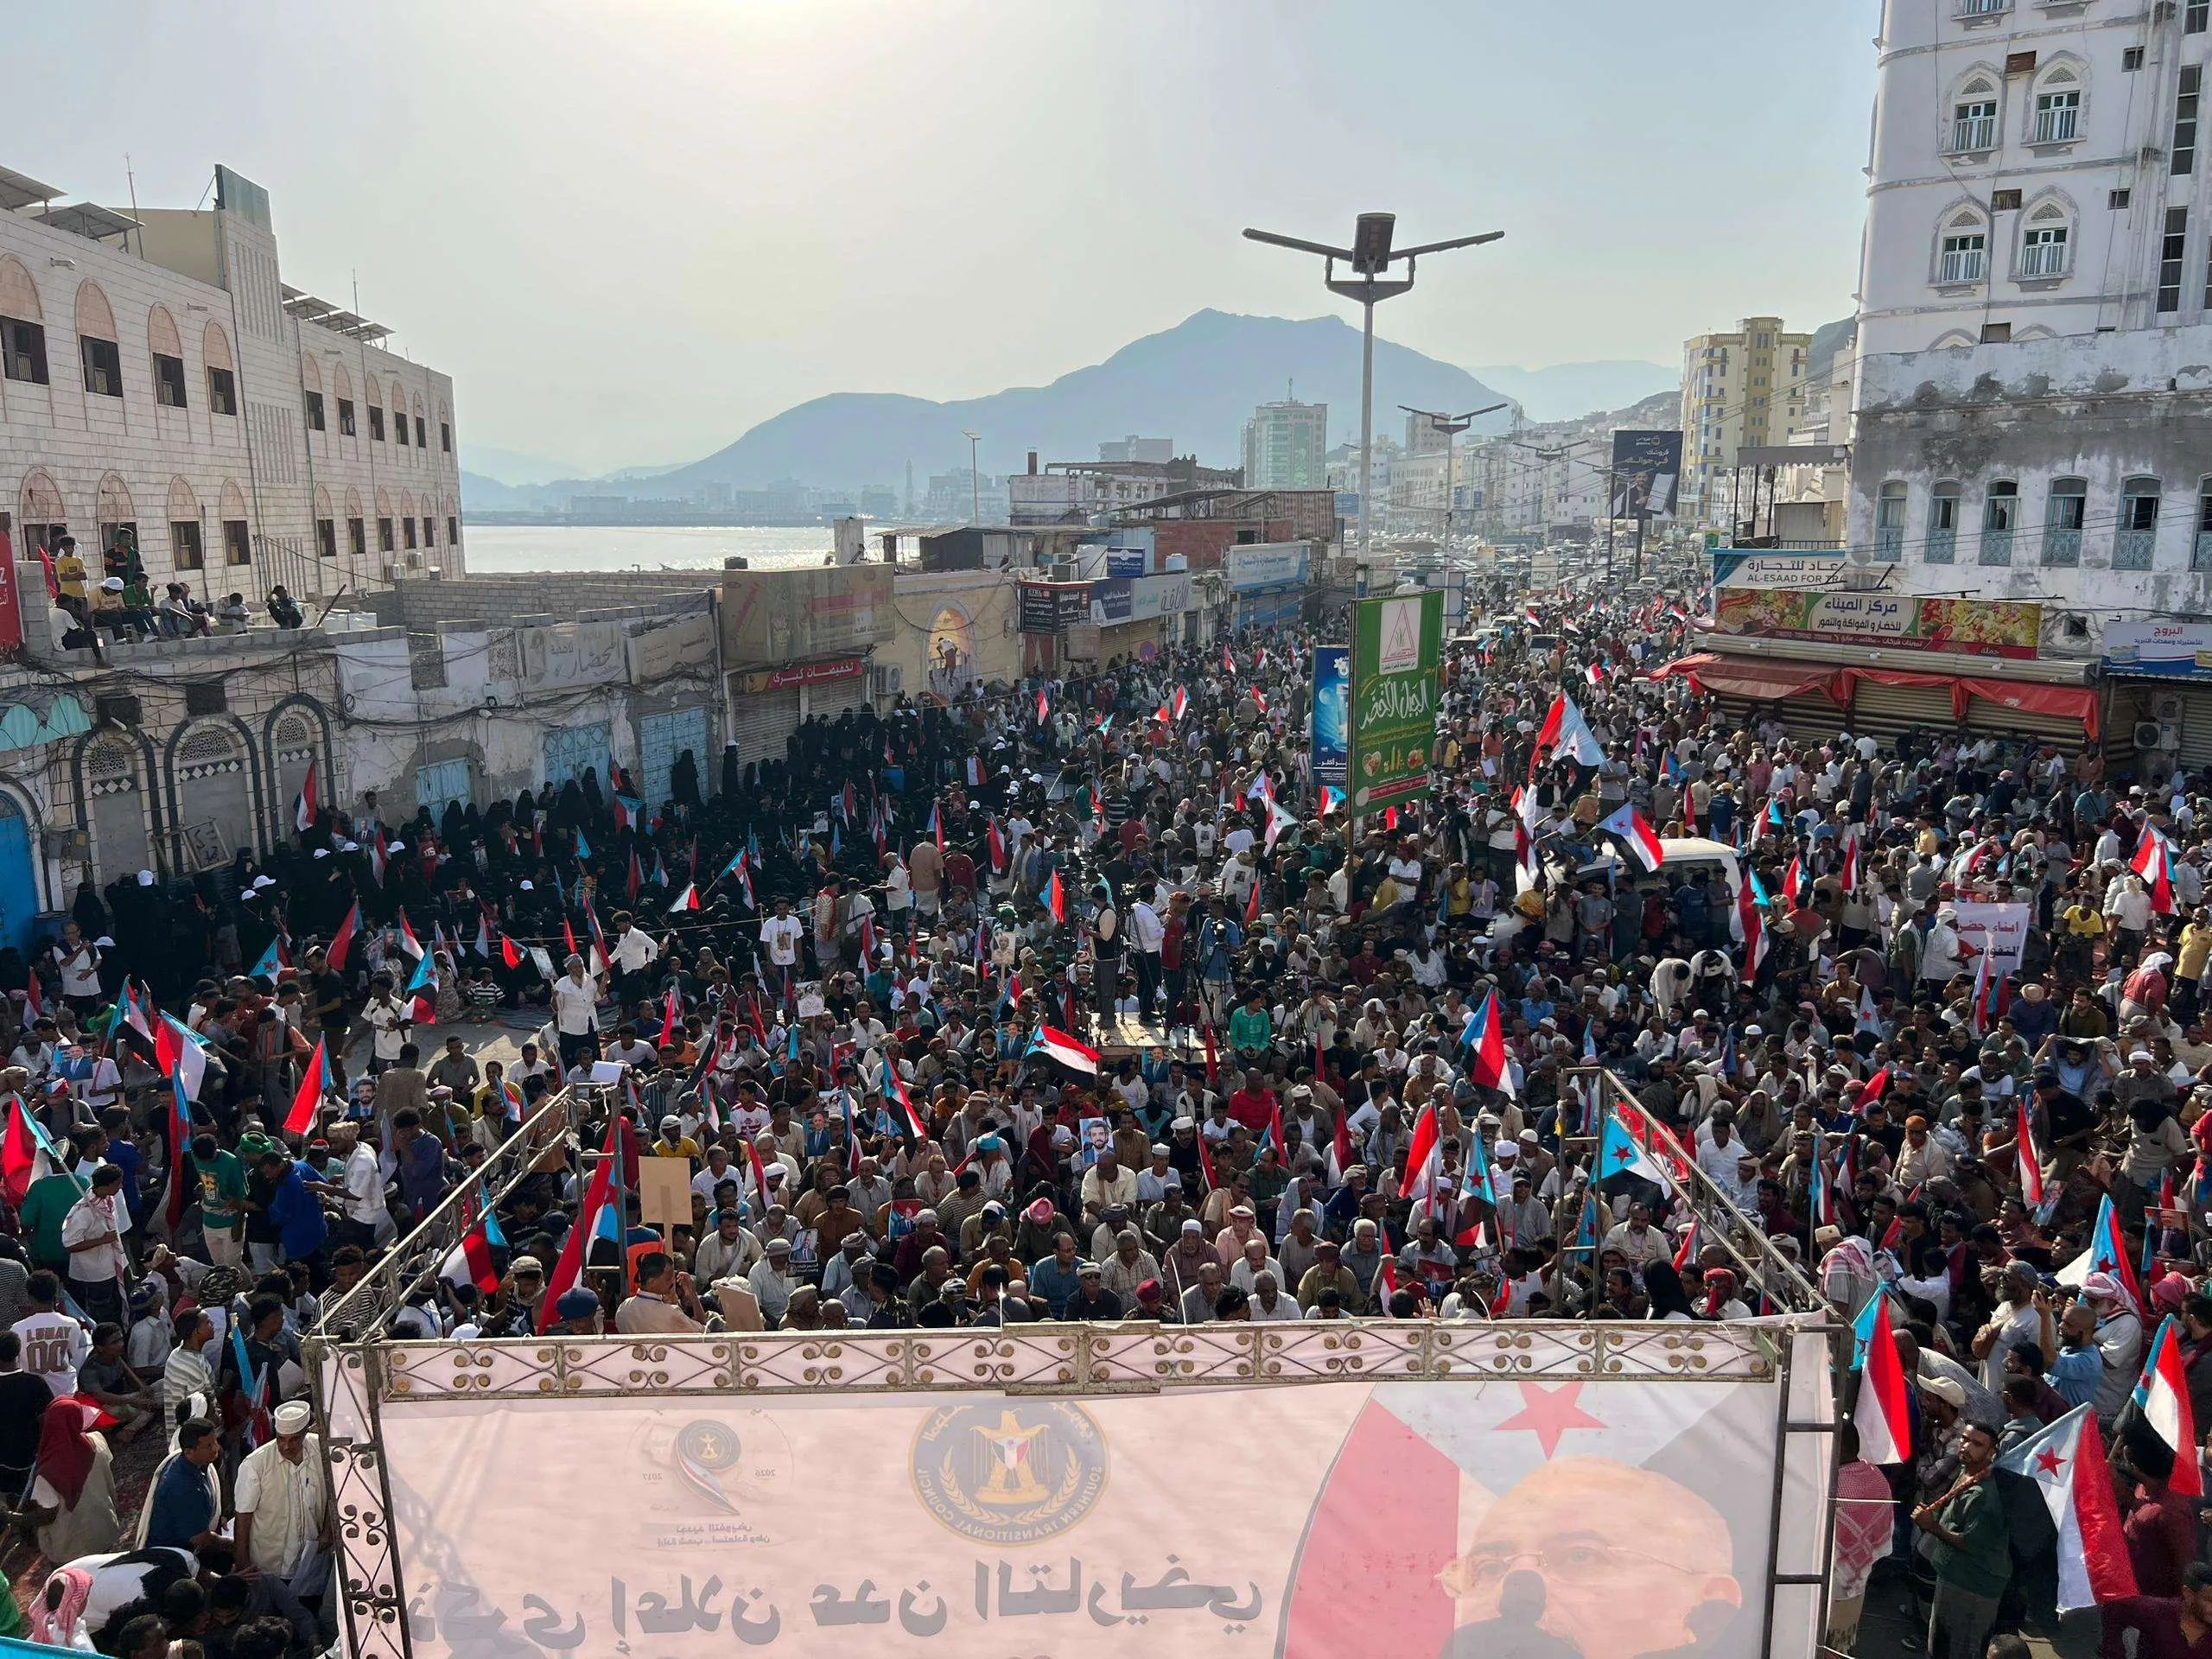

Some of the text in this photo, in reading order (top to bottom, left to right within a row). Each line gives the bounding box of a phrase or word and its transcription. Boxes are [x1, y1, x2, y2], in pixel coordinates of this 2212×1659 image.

[1824, 597, 1897, 616] مركز الميناء
[1876, 621, 1901, 632] للخضار
[2153, 626, 2183, 637] البروج
[772, 662, 854, 686] تخفيضات كبرى
